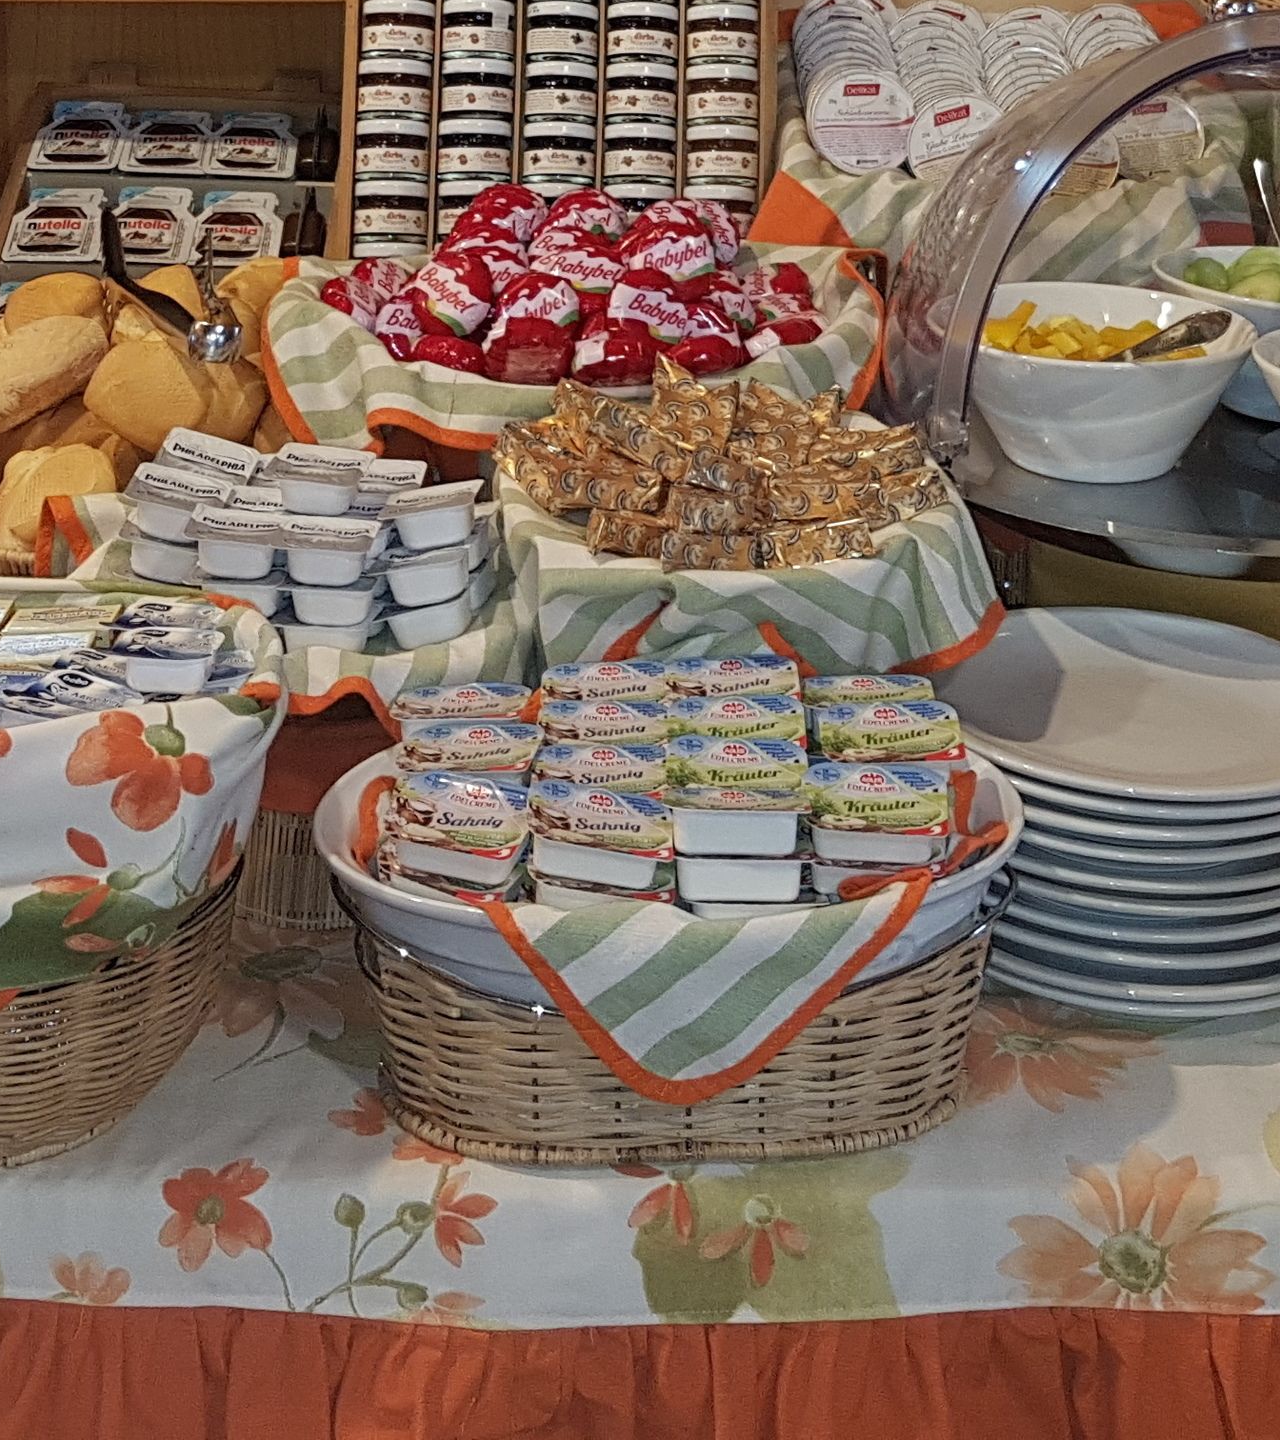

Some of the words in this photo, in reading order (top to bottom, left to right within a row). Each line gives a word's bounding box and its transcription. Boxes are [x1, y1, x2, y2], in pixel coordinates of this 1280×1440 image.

[846, 86, 878, 95] Delikat
[935, 108, 968, 124] Delikat
[54, 130, 111, 141] nutella
[142, 135, 199, 144] nutella
[223, 136, 276, 147] nutella
[27, 218, 82, 231] nutella
[119, 219, 172, 231] nutella
[644, 242, 707, 269] Babybel
[551, 256, 620, 281] Babybel
[420, 266, 471, 314] Babybel
[628, 293, 686, 330] Babybe
[172, 442, 247, 472] PHILADELPHIA
[144, 473, 222, 496] PHILADELPHIA
[586, 683, 647, 699] Sahnig
[710, 677, 770, 696] Sahnig
[583, 724, 646, 738] Sahnig
[707, 721, 780, 738] Kräuter
[861, 727, 934, 746] Kräuter
[445, 745, 512, 761] Sahnig
[579, 769, 643, 784] Sahnig
[707, 768, 782, 783] Kräuter
[843, 799, 920, 815] Kräuter
[436, 812, 504, 829] Sahnig
[574, 817, 642, 834] Sahnig
